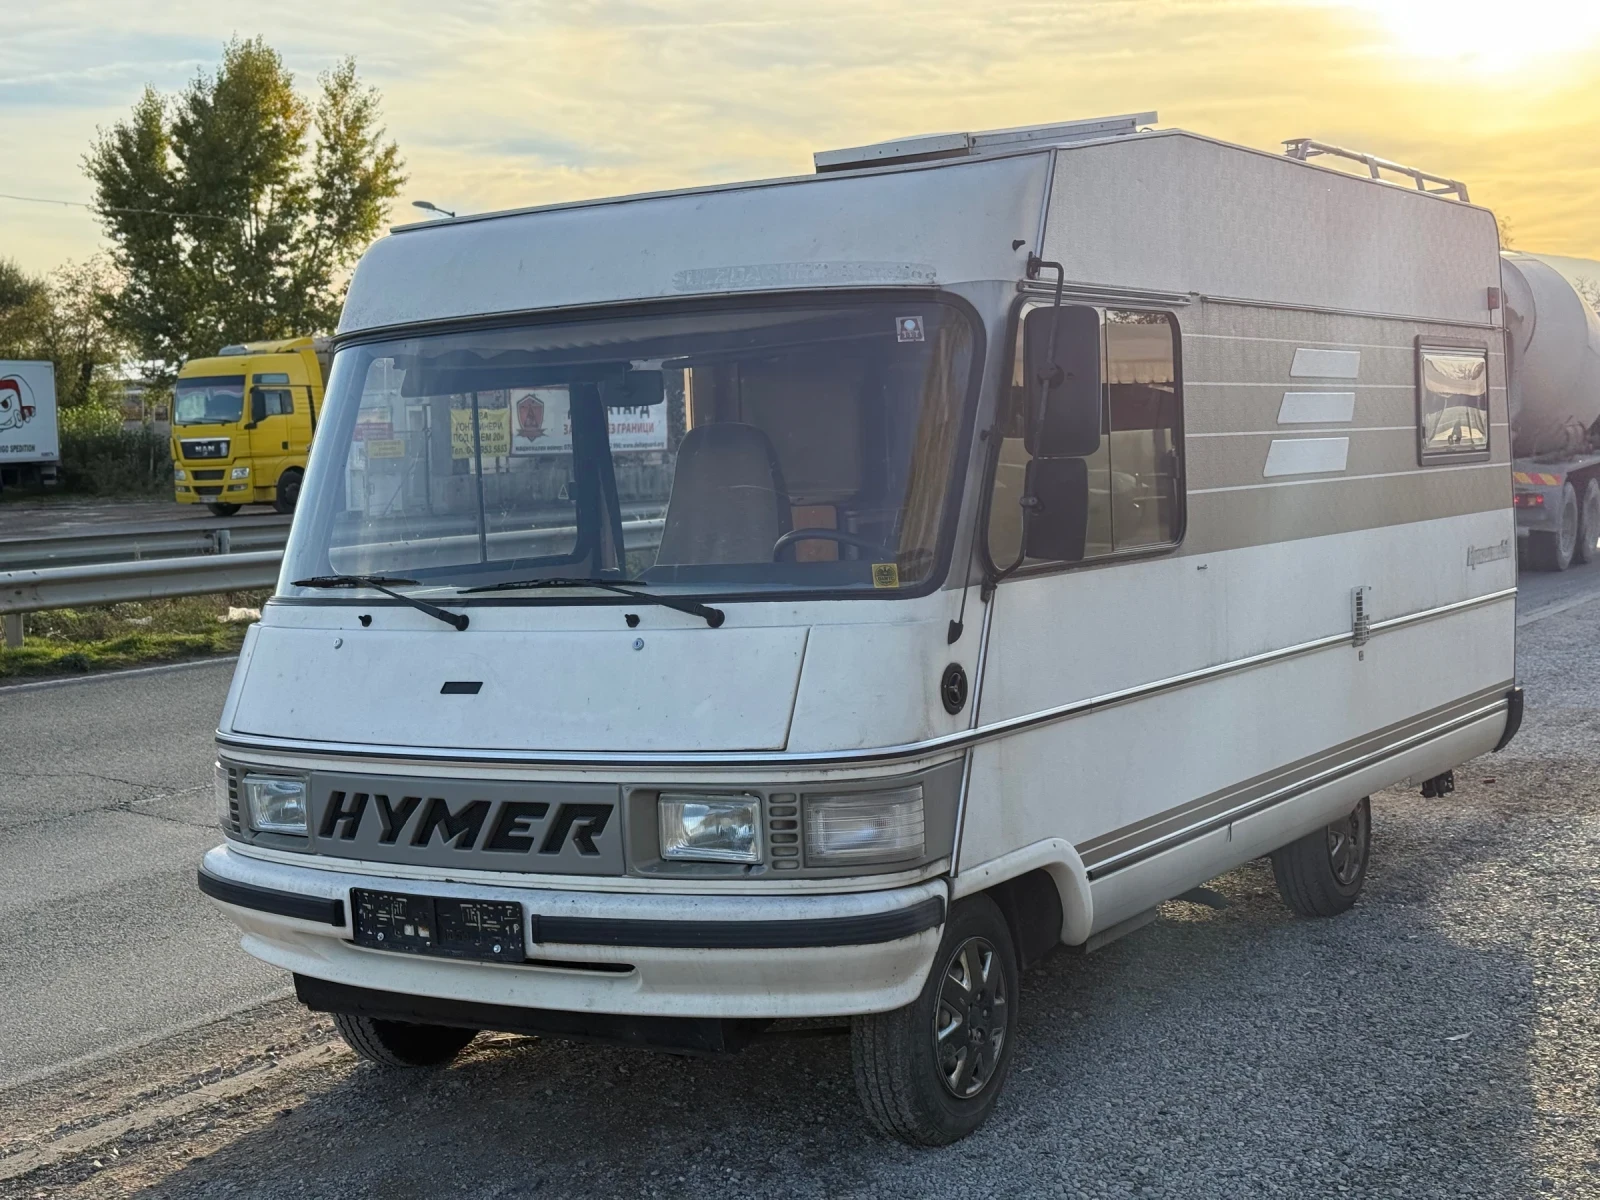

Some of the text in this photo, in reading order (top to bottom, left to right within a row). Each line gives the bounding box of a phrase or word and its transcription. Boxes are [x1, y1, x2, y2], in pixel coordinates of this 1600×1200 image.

[455, 422, 504, 432] КОНТЙНЕРИ
[617, 422, 655, 435] ГРАНИЦИ
[470, 433, 492, 442] НЕМ
[10, 444, 36, 453] SPEDITION
[195, 445, 215, 453] MAN
[318, 790, 614, 856] HYMER
